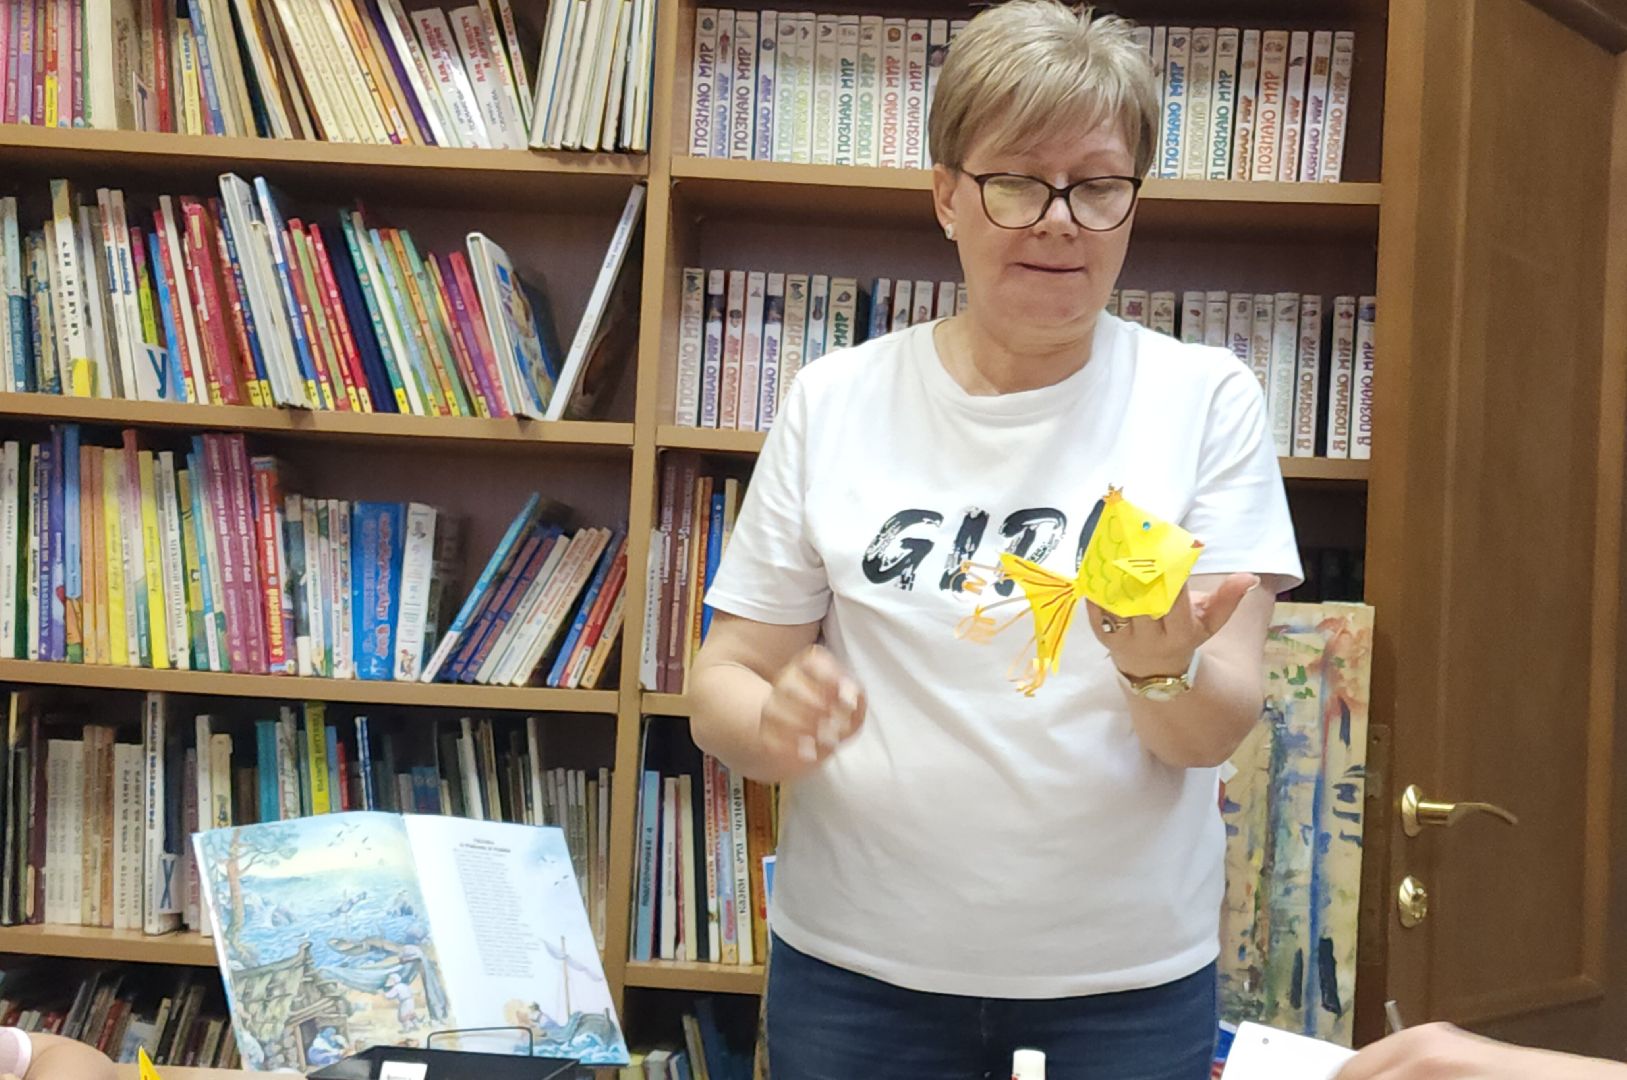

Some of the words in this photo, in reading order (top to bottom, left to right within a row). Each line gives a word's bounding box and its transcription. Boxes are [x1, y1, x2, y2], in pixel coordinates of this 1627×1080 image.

[698, 42, 714, 78] МИР
[737, 46, 752, 80] МИР
[841, 58, 855, 89] МИР
[886, 55, 901, 88] МИР
[909, 60, 922, 92] МИР
[1170, 61, 1184, 97] МИР
[1218, 69, 1233, 102] МИР
[1263, 71, 1280, 105] МИР
[694, 82, 711, 149] ПОЗНАЮ
[733, 86, 750, 151] ПОЗНАЮ
[837, 93, 853, 153] ПОЗНАЮ
[883, 92, 899, 155] ПОЗНАЮ
[905, 96, 921, 156] ПОЗНАЮ
[1165, 102, 1182, 168] ПОЗНАЮ
[1212, 106, 1229, 168] ПОЗНАЮ
[1257, 109, 1276, 174] ПОЗНАЮ
[833, 311, 849, 347] МИР
[1302, 336, 1316, 369] МИР
[1338, 337, 1352, 370] МИР
[1363, 341, 1375, 371] МИР
[1298, 372, 1313, 434] ПОЗНАЮ
[1335, 374, 1349, 436] ПОЗНАЮ
[1359, 375, 1374, 432] ПОЗНАЮ
[1333, 439, 1347, 451] Я
[1357, 436, 1371, 446] Я
[862, 498, 1105, 597] GID
